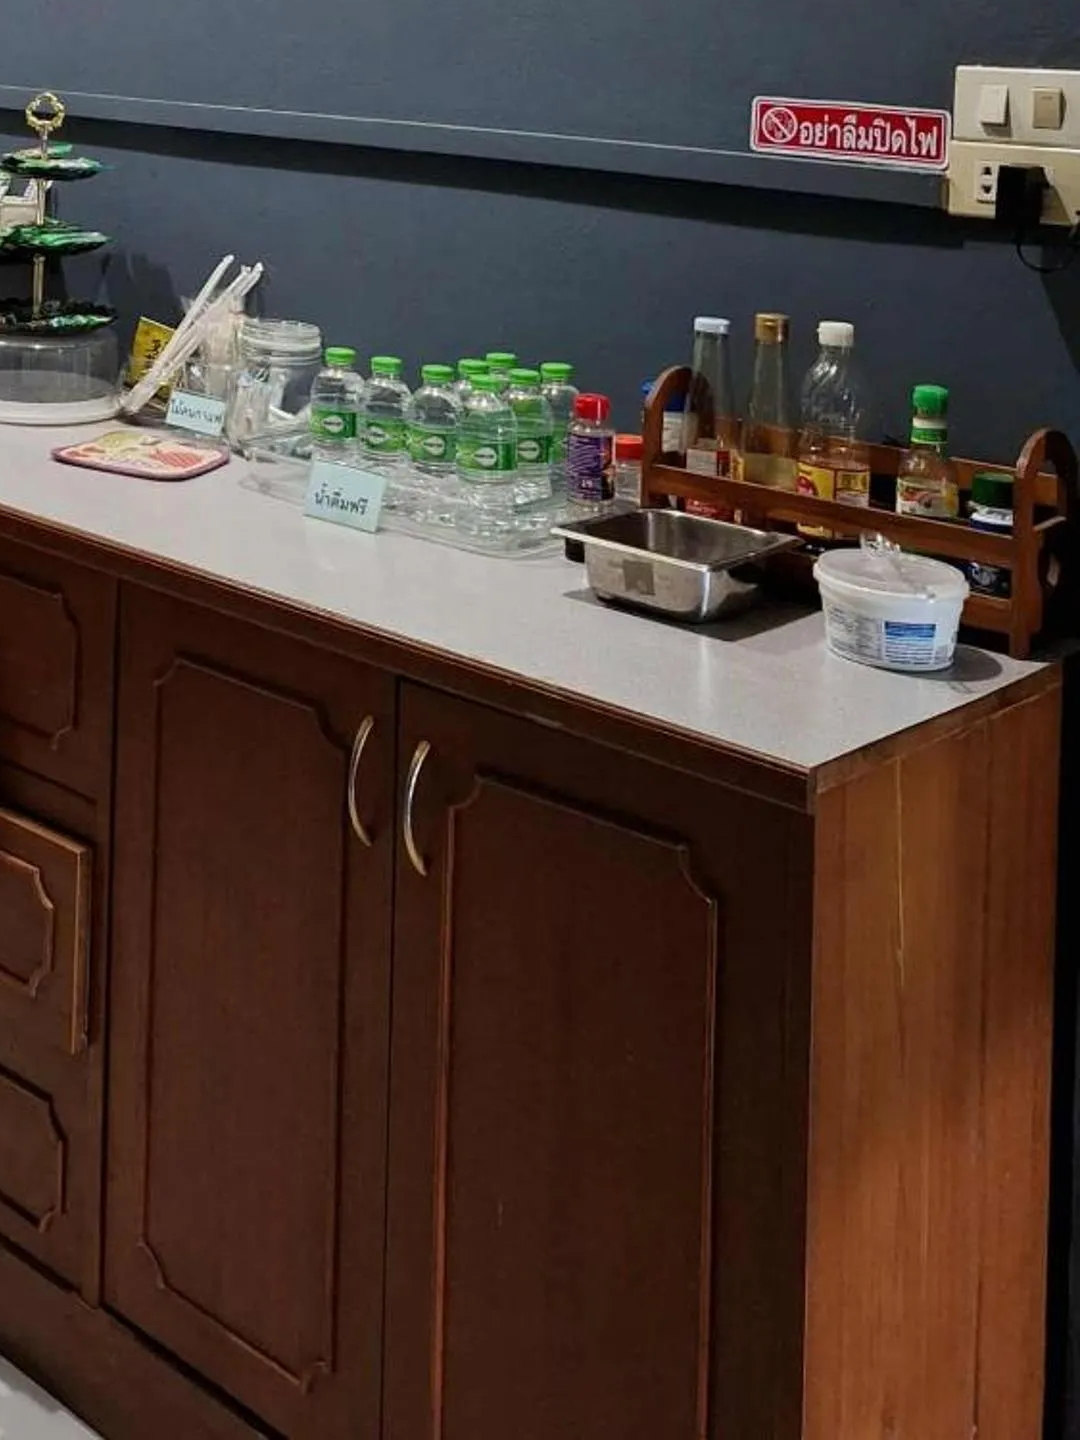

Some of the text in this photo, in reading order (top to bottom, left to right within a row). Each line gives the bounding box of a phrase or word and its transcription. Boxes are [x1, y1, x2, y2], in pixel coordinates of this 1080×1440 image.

[799, 114, 938, 158] อย่าลืมปิดไฟ
